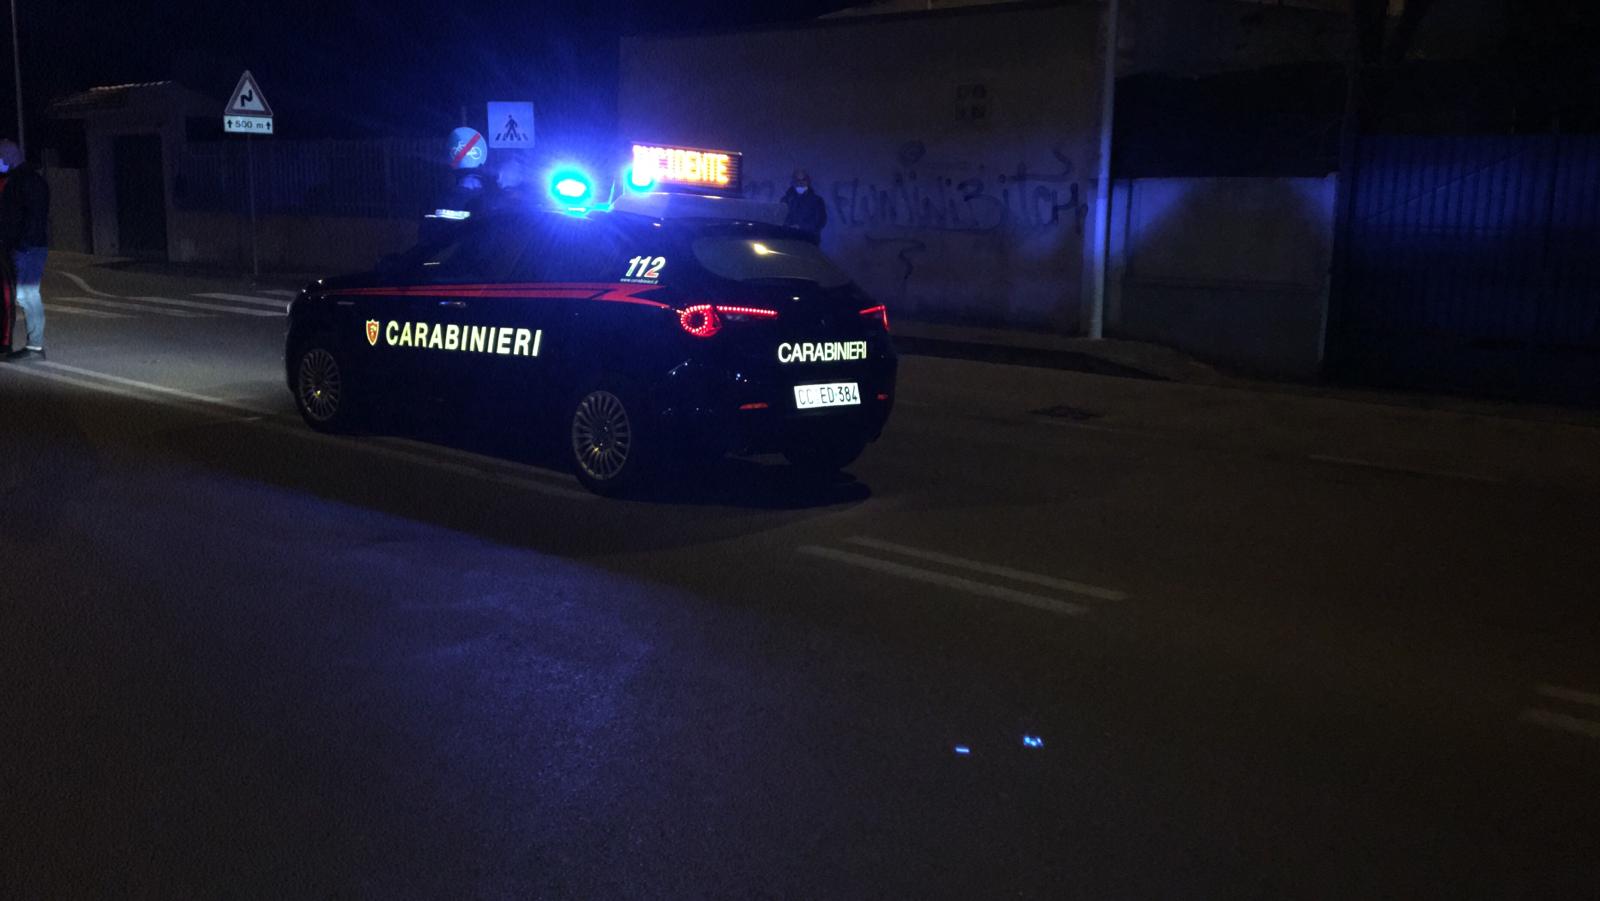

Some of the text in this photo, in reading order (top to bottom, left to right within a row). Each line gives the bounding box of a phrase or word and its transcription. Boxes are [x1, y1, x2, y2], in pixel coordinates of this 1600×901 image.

[235, 120, 253, 128] 500
[625, 255, 666, 278] 112
[385, 320, 543, 357] CARABINIERI
[777, 341, 867, 363] CARABINIERI
[820, 387, 835, 404] ED
[838, 386, 858, 402] 384
